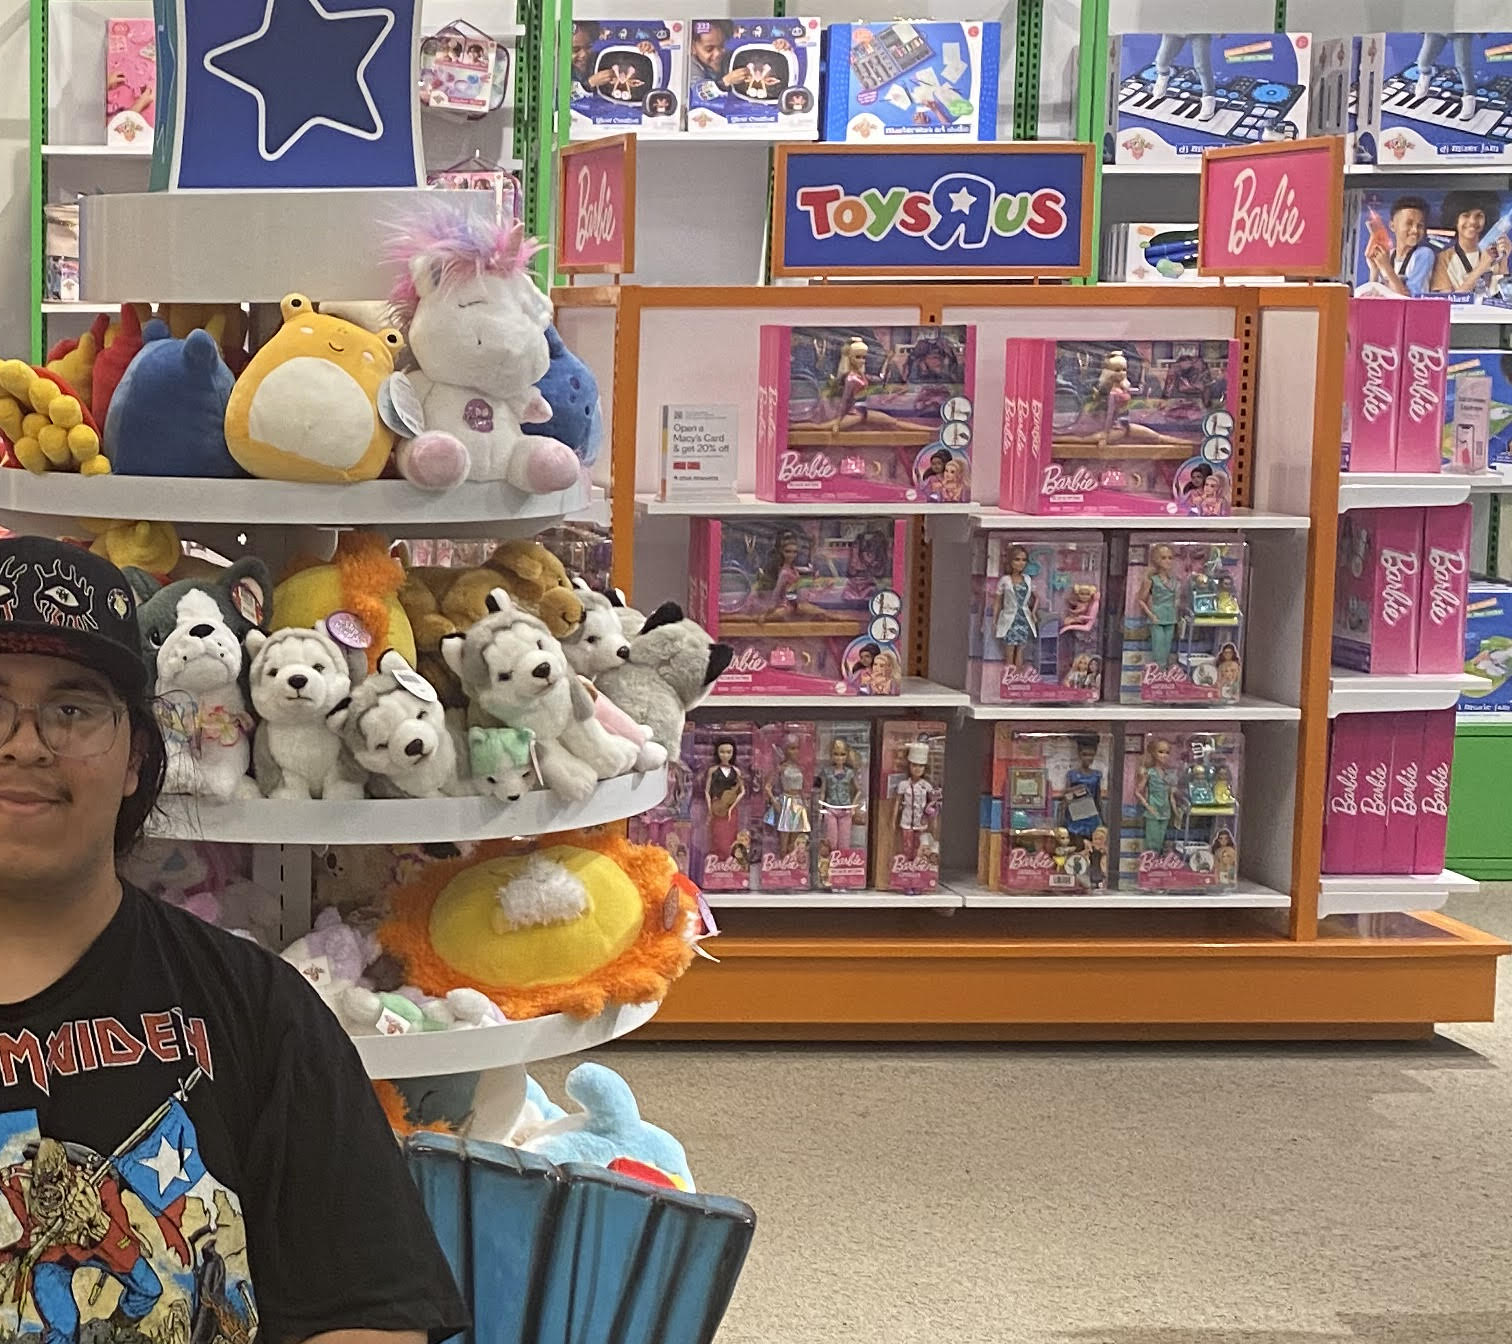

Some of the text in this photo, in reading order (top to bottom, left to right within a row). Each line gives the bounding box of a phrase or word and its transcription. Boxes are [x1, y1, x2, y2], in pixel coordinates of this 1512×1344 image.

[575, 164, 617, 252] Barbie
[1227, 167, 1306, 255] Barbie
[1361, 343, 1400, 423] Barbie
[1407, 344, 1446, 423] Barbie
[673, 423, 697, 433] Open
[673, 433, 725, 443] Macy's Card
[673, 444, 730, 454] & get 20% off
[778, 451, 837, 482] Barbie
[1041, 463, 1099, 495] Barbie
[1381, 548, 1418, 627] Barbie
[1429, 547, 1466, 626] Barbie
[725, 647, 768, 672] arbie
[1001, 664, 1040, 685] Barbie
[1143, 663, 1187, 685] Barbie
[1332, 760, 1358, 816] Barbie
[1360, 762, 1388, 817] Barbie
[1391, 761, 1419, 817] Barbie
[1422, 760, 1449, 816] Barbie
[705, 854, 742, 873] Barbie
[761, 852, 799, 872] Barbie
[829, 850, 865, 867] Barbie
[892, 854, 928, 873] Barbie
[1008, 848, 1056, 869] Barbie
[1139, 851, 1185, 872] Barbie
